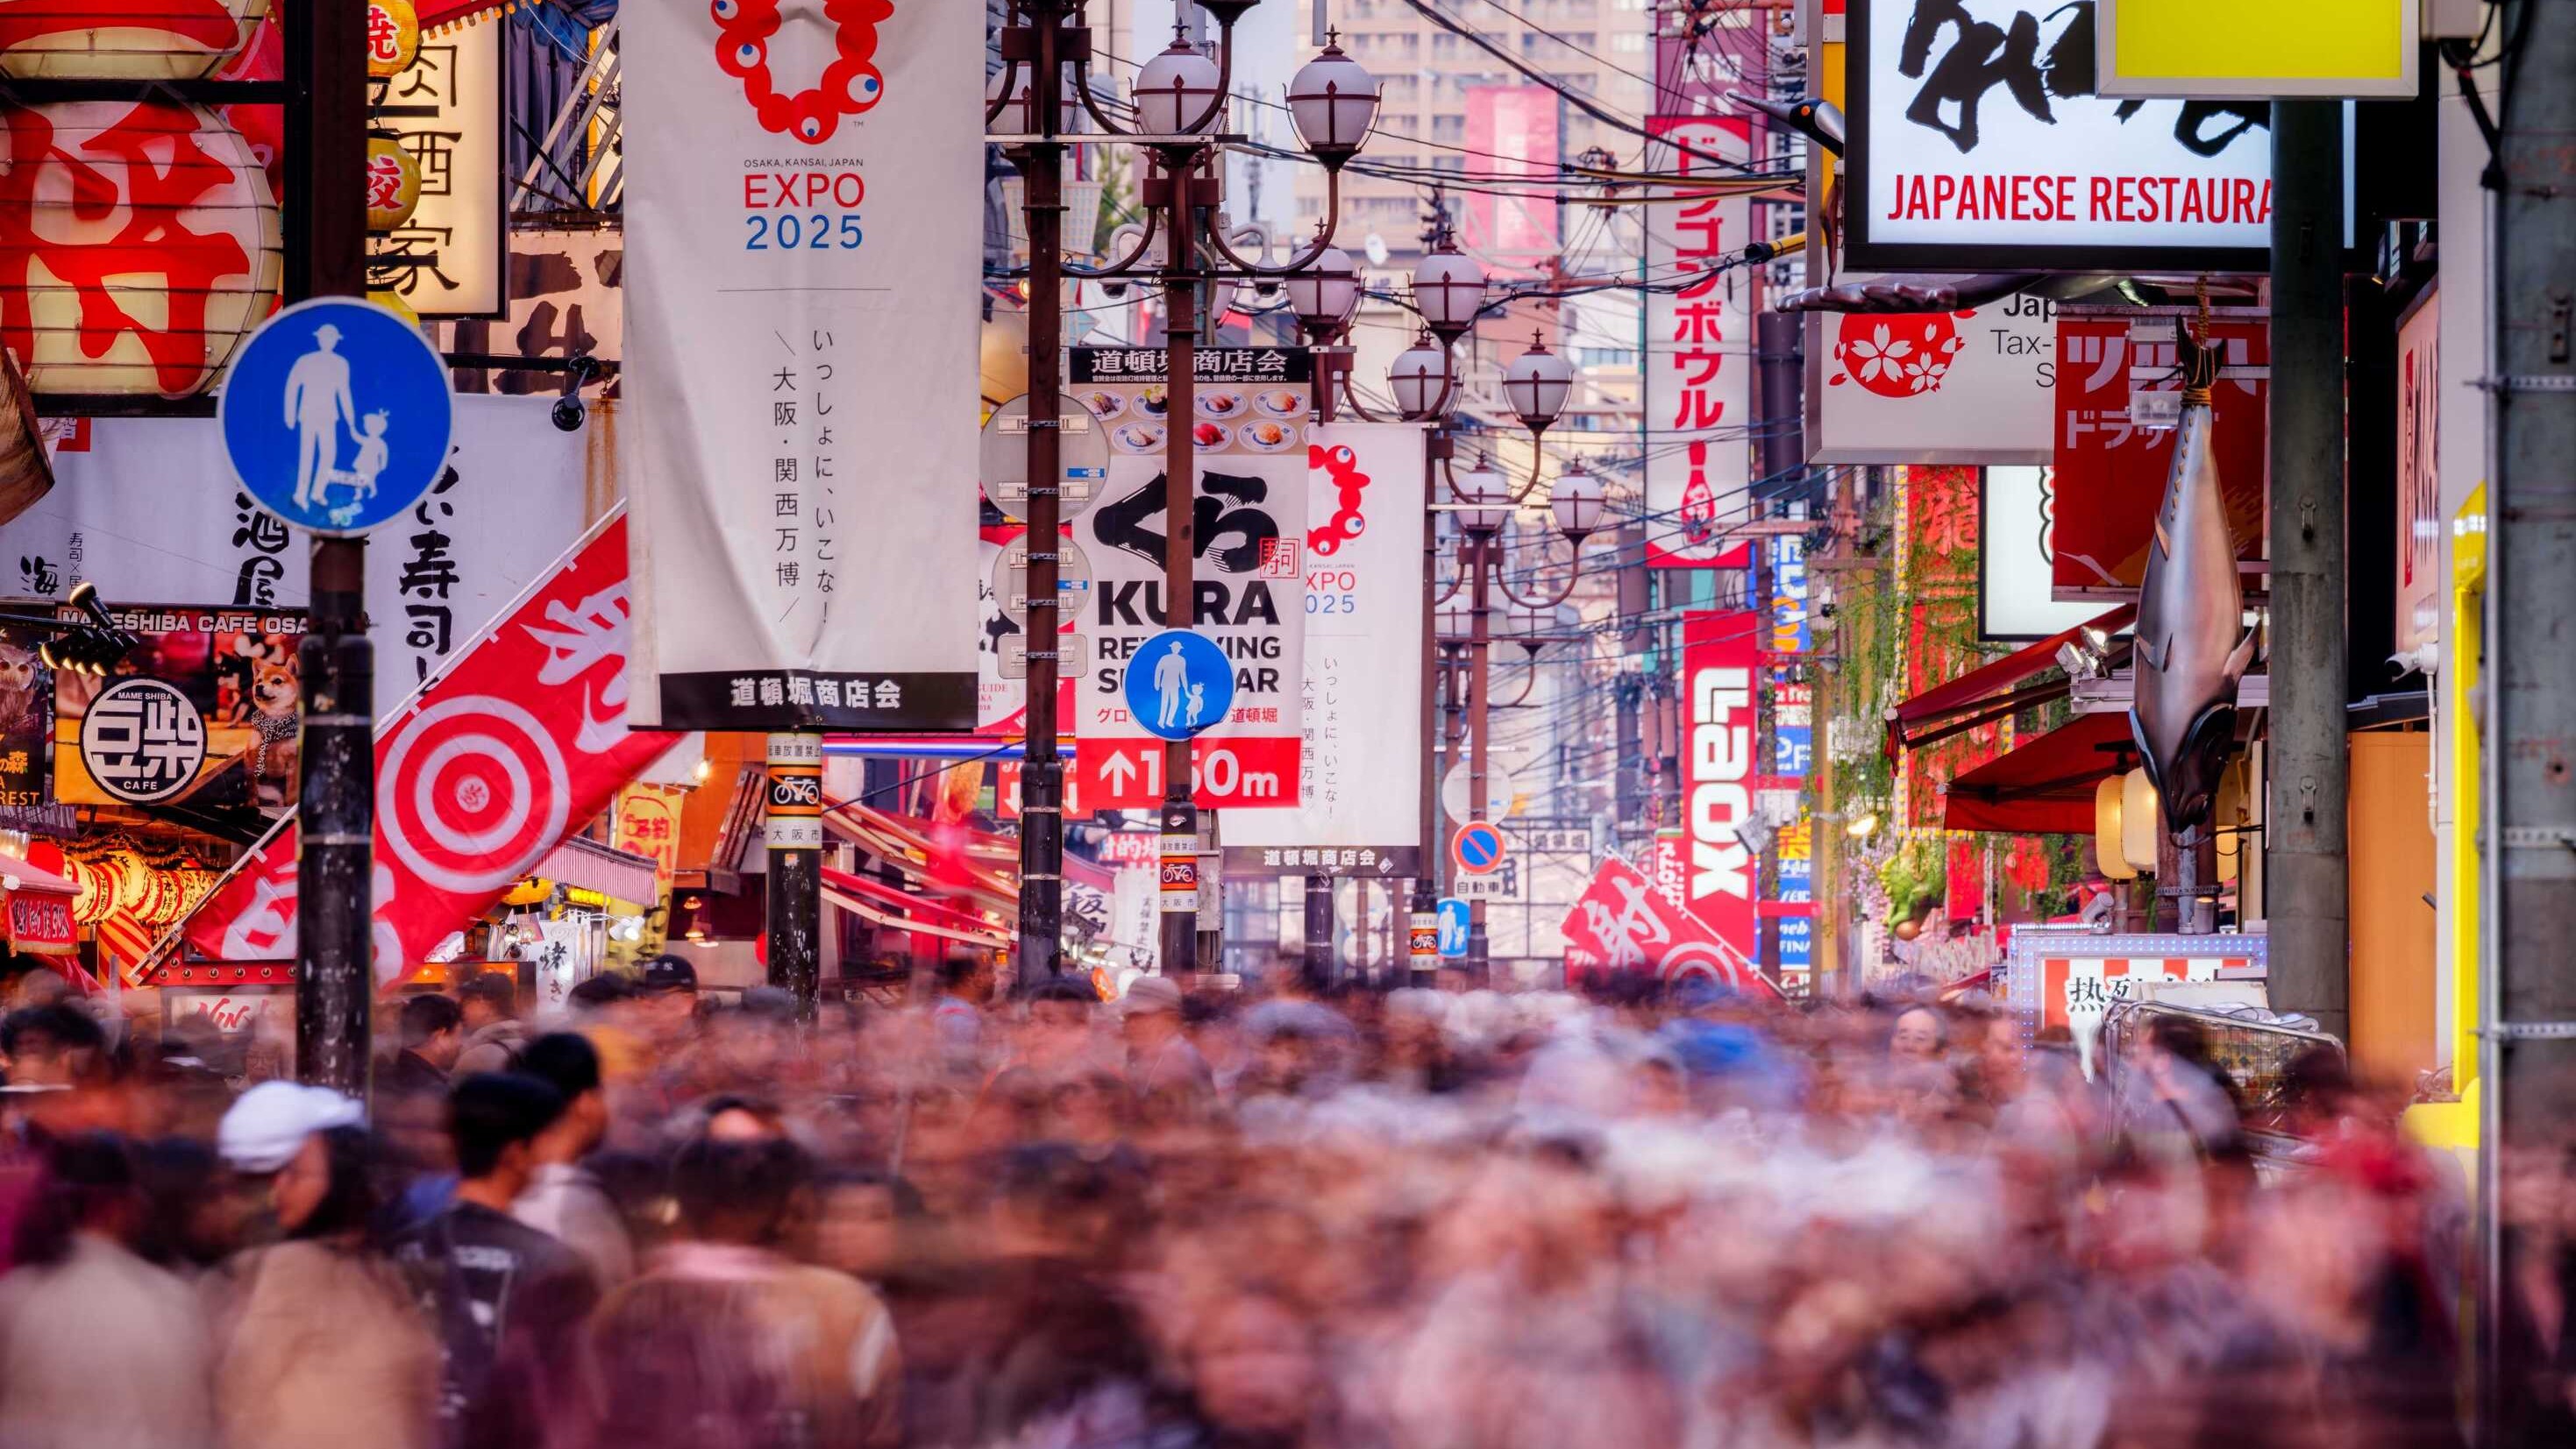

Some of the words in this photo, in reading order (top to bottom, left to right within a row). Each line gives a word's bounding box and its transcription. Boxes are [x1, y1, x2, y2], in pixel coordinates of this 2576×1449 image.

[744, 159, 784, 168] OSAKA,
[785, 158, 828, 167] KANSAI,
[829, 158, 864, 167] JAPAN
[744, 173, 865, 209] EXPO
[1888, 174, 2076, 221] JAPANESE
[745, 215, 864, 250] 2025
[1990, 330, 2053, 354] Tax-
[231, 491, 291, 607] 酒屋
[1306, 572, 1356, 592] XPO
[1098, 580, 1281, 627] KURA
[1305, 594, 1355, 614] 025
[62, 609, 191, 633] MAESHIBA
[198, 615, 258, 634] CAFE
[265, 617, 310, 635] OSA
[118, 691, 143, 700] MAME
[145, 692, 173, 700] SHIBA
[730, 678, 900, 709] 道頓堀商店会
[1231, 707, 1277, 723] 道頓堀
[124, 781, 158, 790] CAFE
[0, 792, 39, 805] REST
[772, 829, 820, 841] 大阪市
[1264, 849, 1376, 867] 道頓堀商店会
[1456, 881, 1500, 893] 自動車
